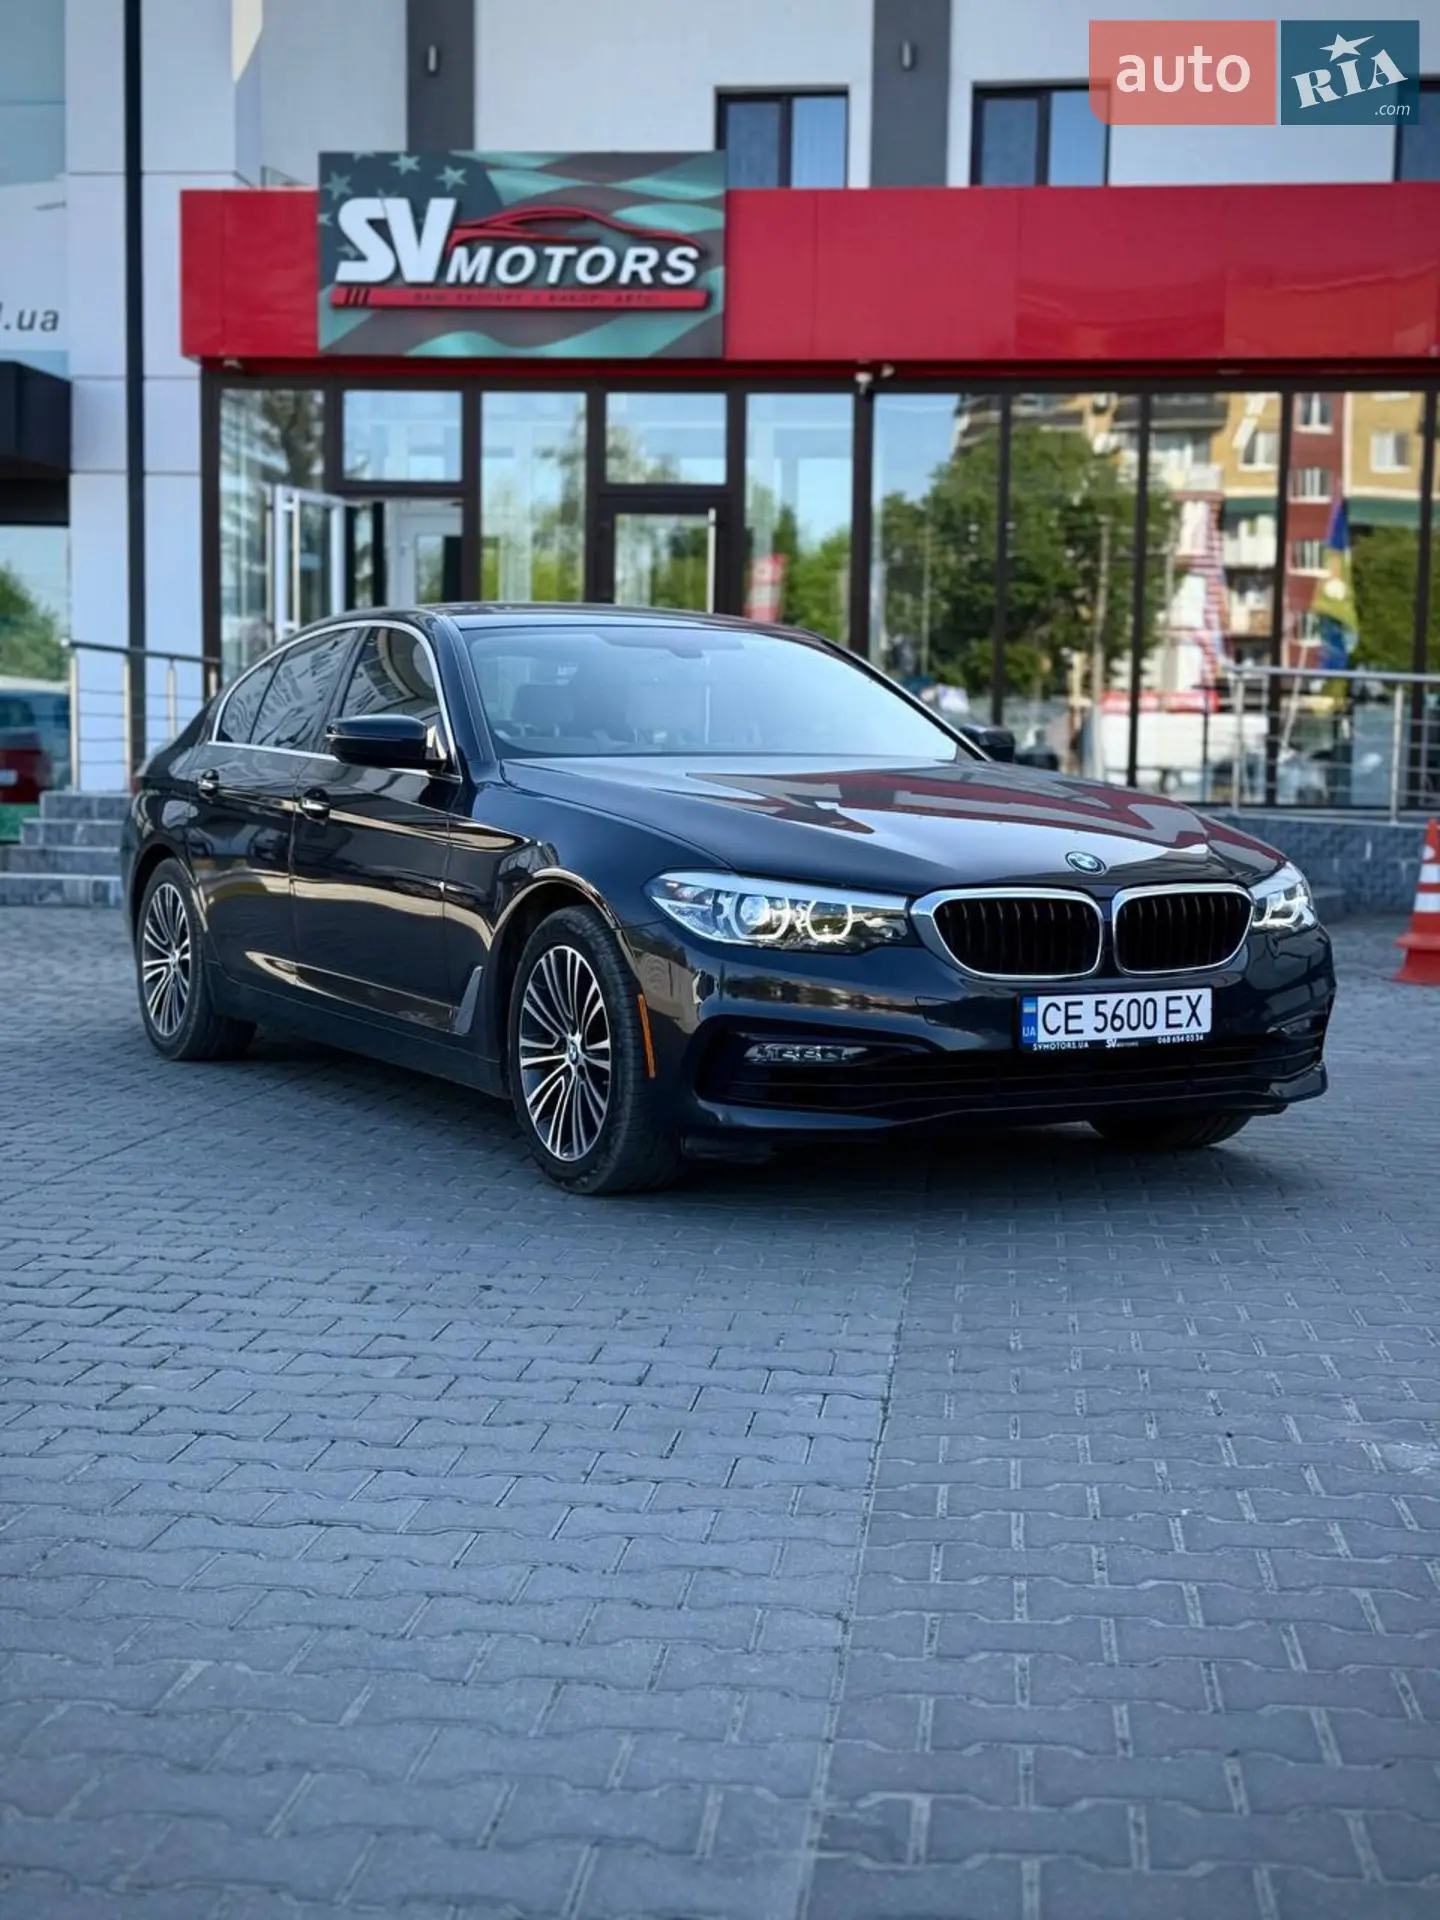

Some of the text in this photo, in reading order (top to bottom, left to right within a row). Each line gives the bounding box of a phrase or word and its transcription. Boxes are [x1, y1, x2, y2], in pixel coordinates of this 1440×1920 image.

[335, 197, 702, 285] SV MOTORS
[1022, 1026, 1037, 1038] UA
[1042, 994, 1203, 1036] CE 5600 EX
